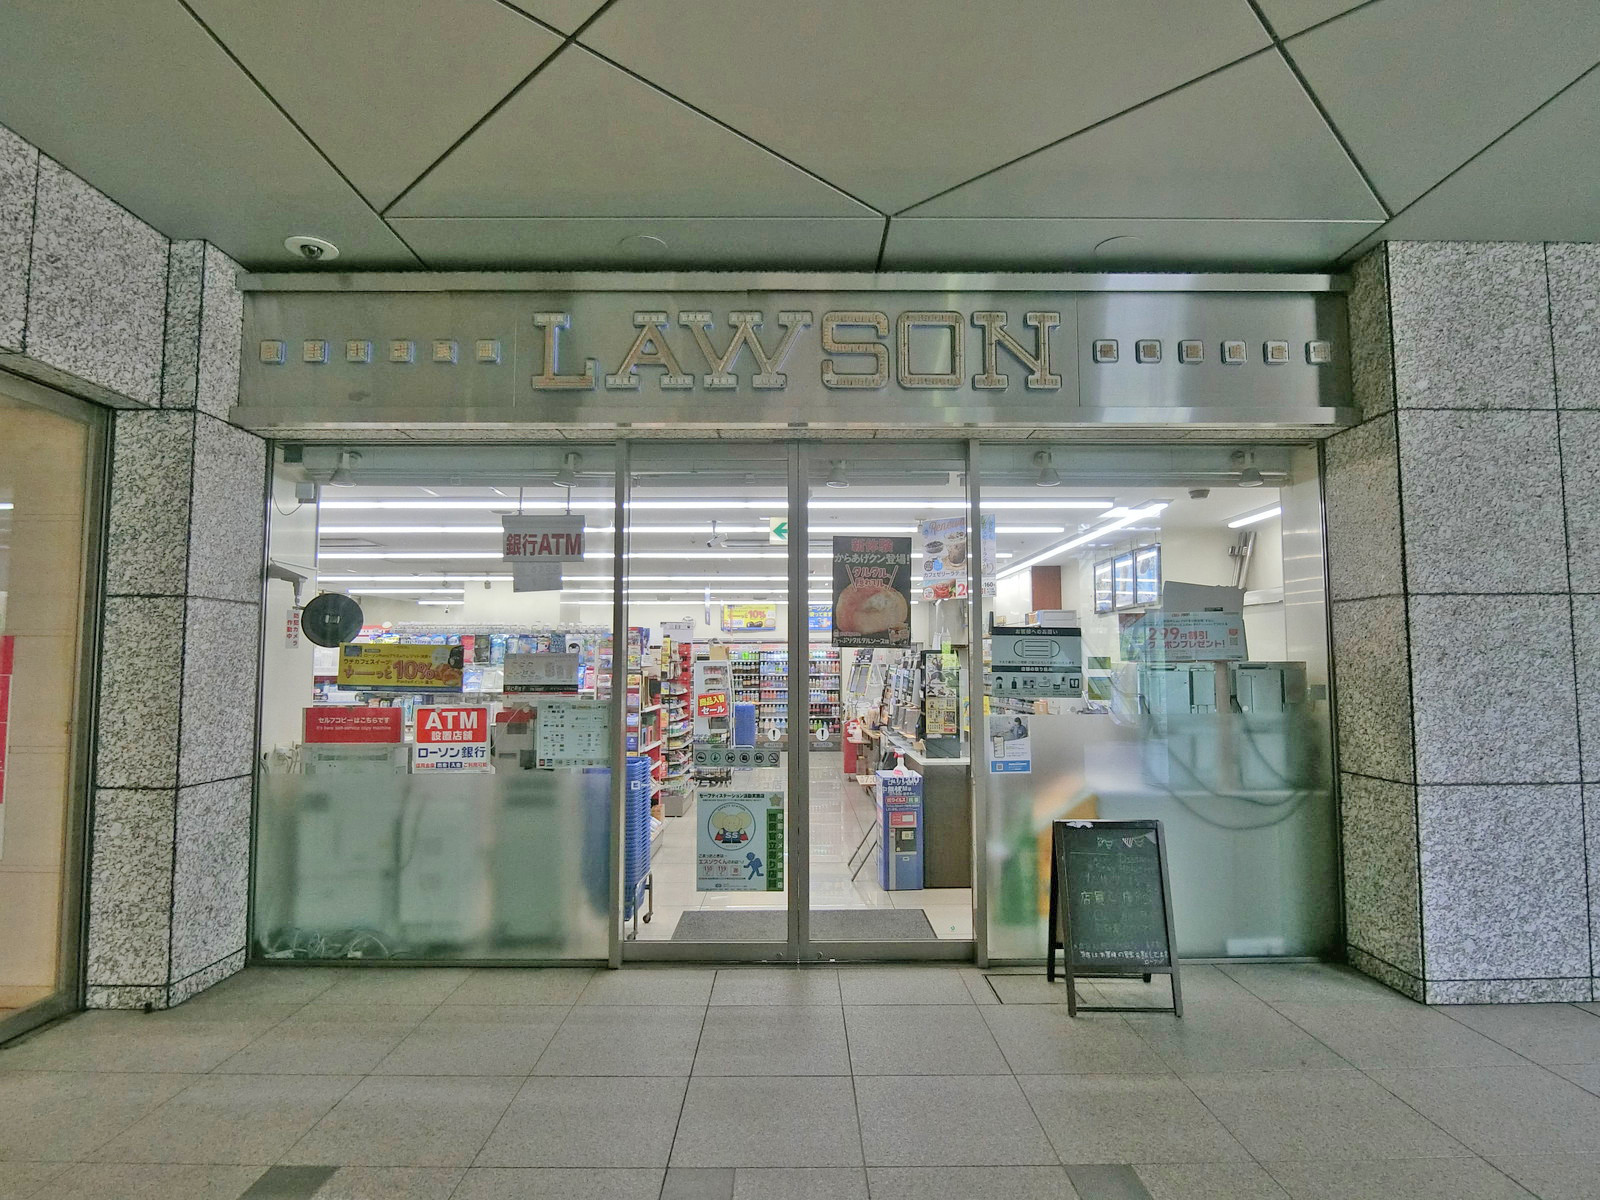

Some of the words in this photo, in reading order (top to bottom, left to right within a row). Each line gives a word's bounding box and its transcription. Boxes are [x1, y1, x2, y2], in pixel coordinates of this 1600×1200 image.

[532, 310, 1063, 391] LAWSON
[506, 533, 582, 556] 銀行ATM
[1148, 640, 1225, 649] クポンプレゼント!
[393, 660, 436, 680] 10%
[701, 705, 725, 714] セール
[425, 711, 478, 730] ATM
[431, 731, 473, 740] 設置店舗
[418, 746, 486, 758] ローソン銀行
